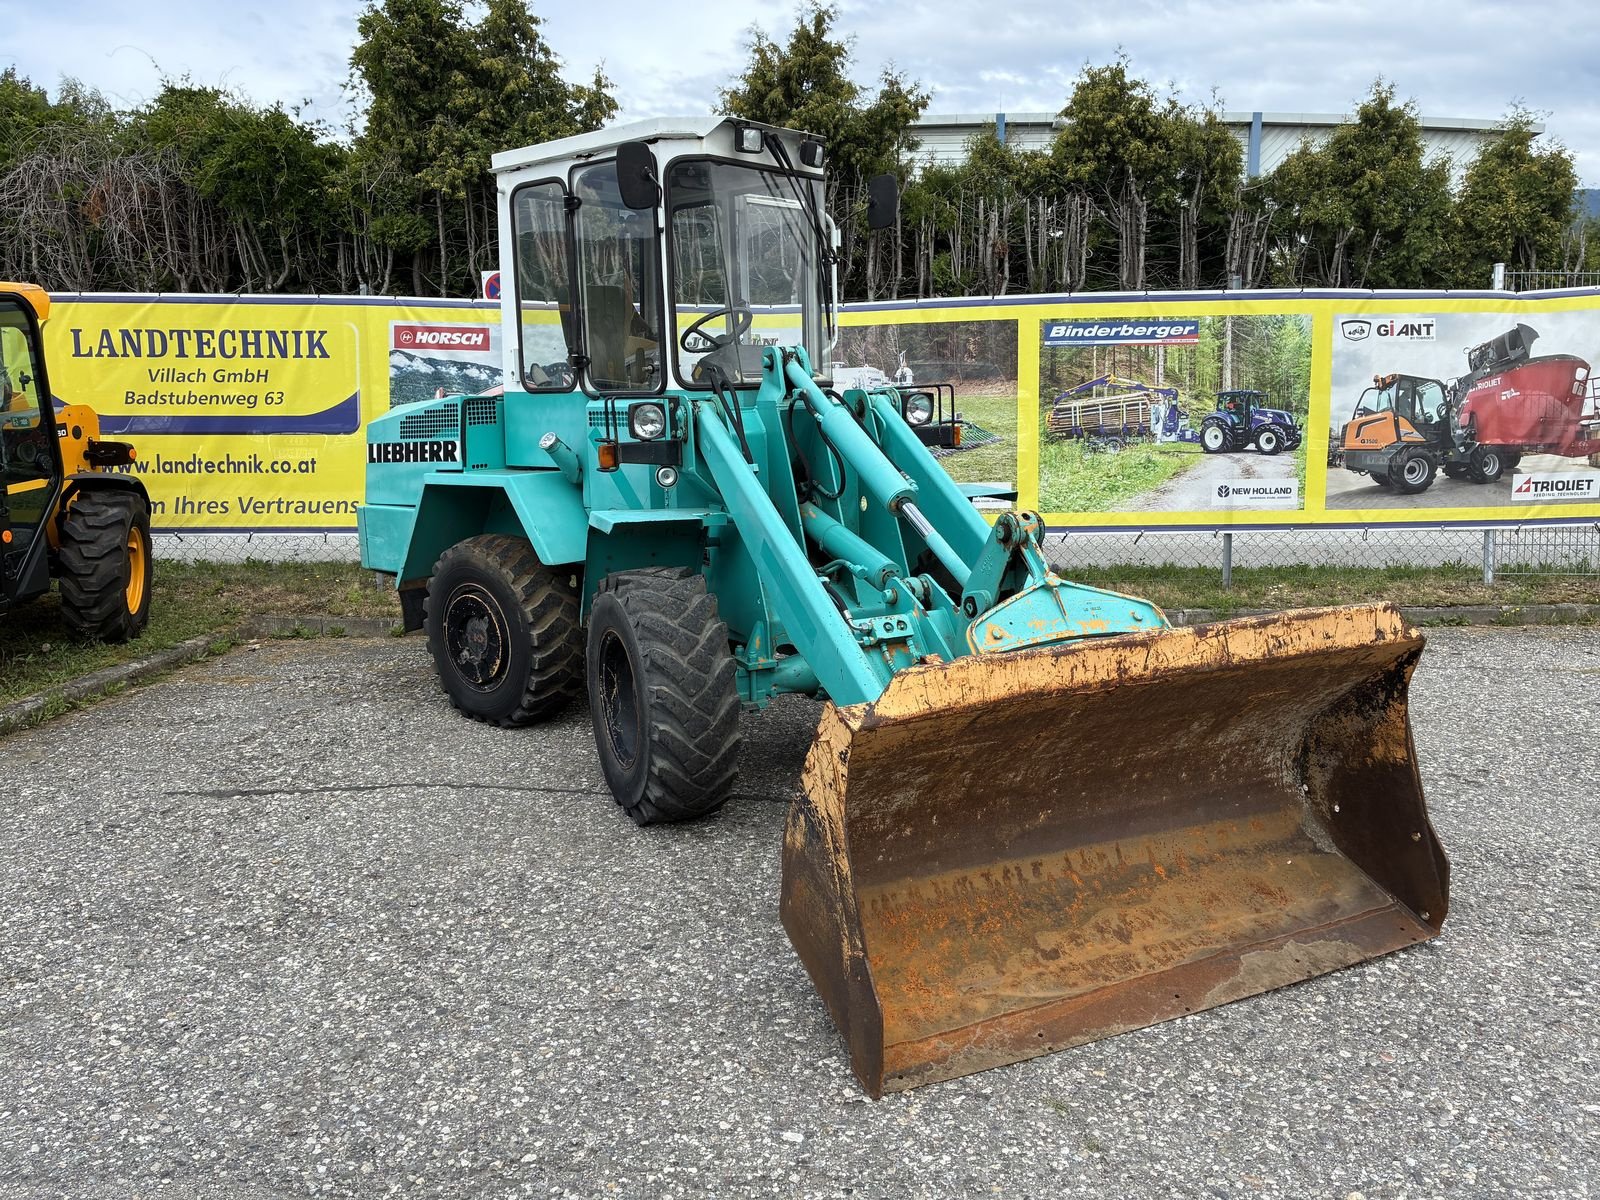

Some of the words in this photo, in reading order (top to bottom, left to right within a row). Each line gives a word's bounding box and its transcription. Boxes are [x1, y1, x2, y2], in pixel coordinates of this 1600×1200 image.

[1050, 323, 1195, 338] Binderberger
[70, 328, 330, 359] LANDTECHNIK
[416, 332, 484, 346] HORSCH
[148, 368, 207, 384] Villach
[212, 368, 269, 384] GmbH
[124, 391, 258, 408] Badstubenweg
[264, 391, 285, 406] 63
[368, 440, 458, 464] LIEBHERR
[1231, 487, 1251, 495] NEW
[1252, 487, 1292, 495] HOLLAND
[1531, 479, 1594, 493] TRIOLIET
[174, 496, 230, 515] Ihres
[238, 497, 359, 515] Vertrauens
